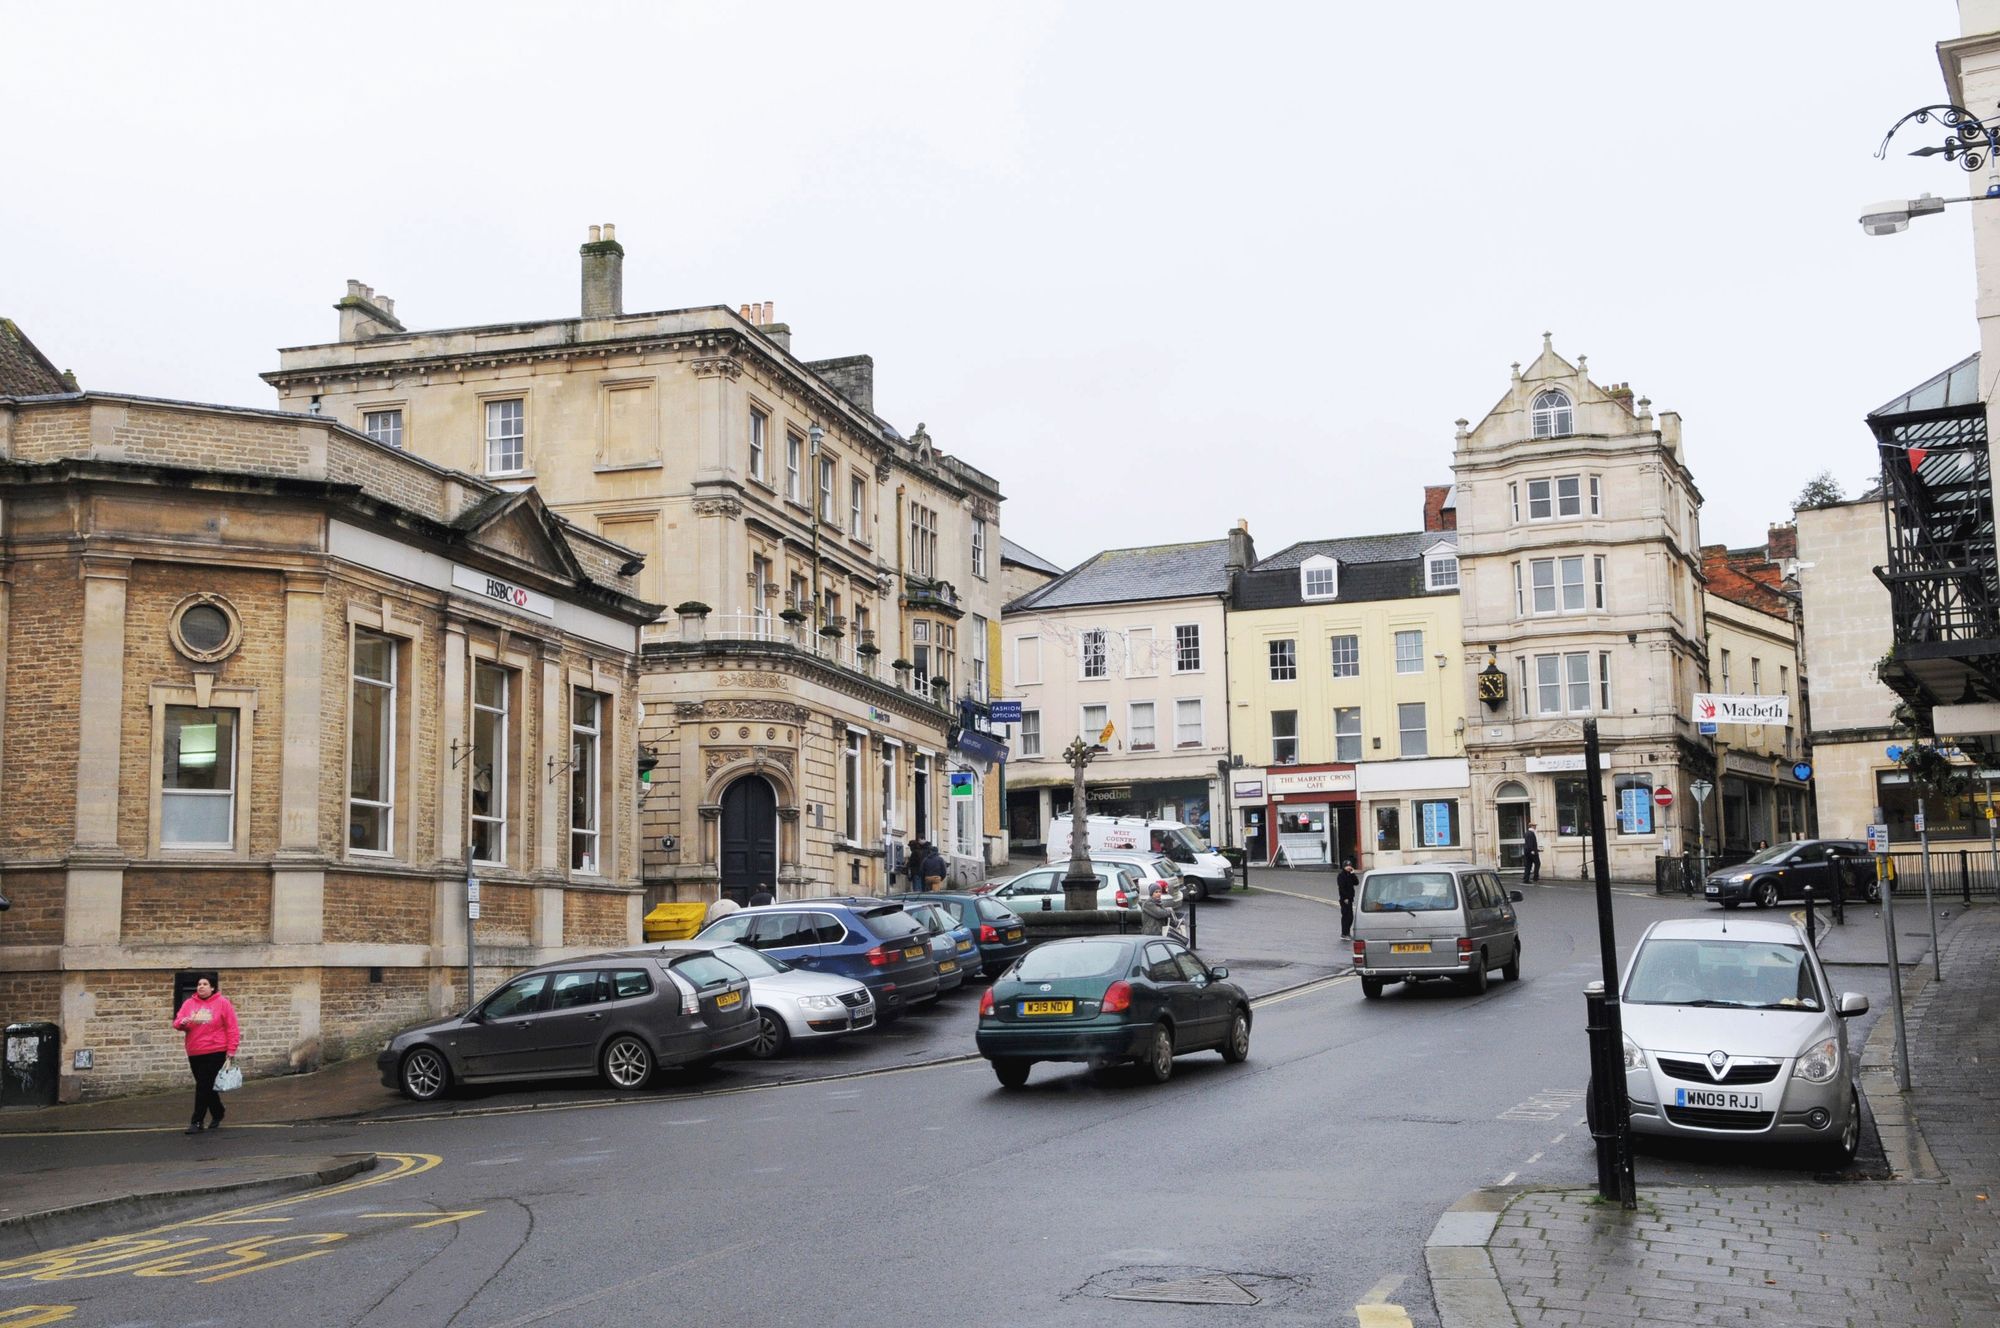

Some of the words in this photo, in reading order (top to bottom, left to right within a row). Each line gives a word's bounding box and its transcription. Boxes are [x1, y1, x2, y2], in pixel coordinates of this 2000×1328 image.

[486, 578, 513, 602] HSBC
[1722, 703, 1783, 717] Macbeth
[1085, 790, 1131, 801] Creedbet
[1028, 1003, 1048, 1012] W319
[1052, 1002, 1069, 1011] NDY
[1687, 1091, 1725, 1107] WN09
[1729, 1094, 1758, 1109] RJJ
